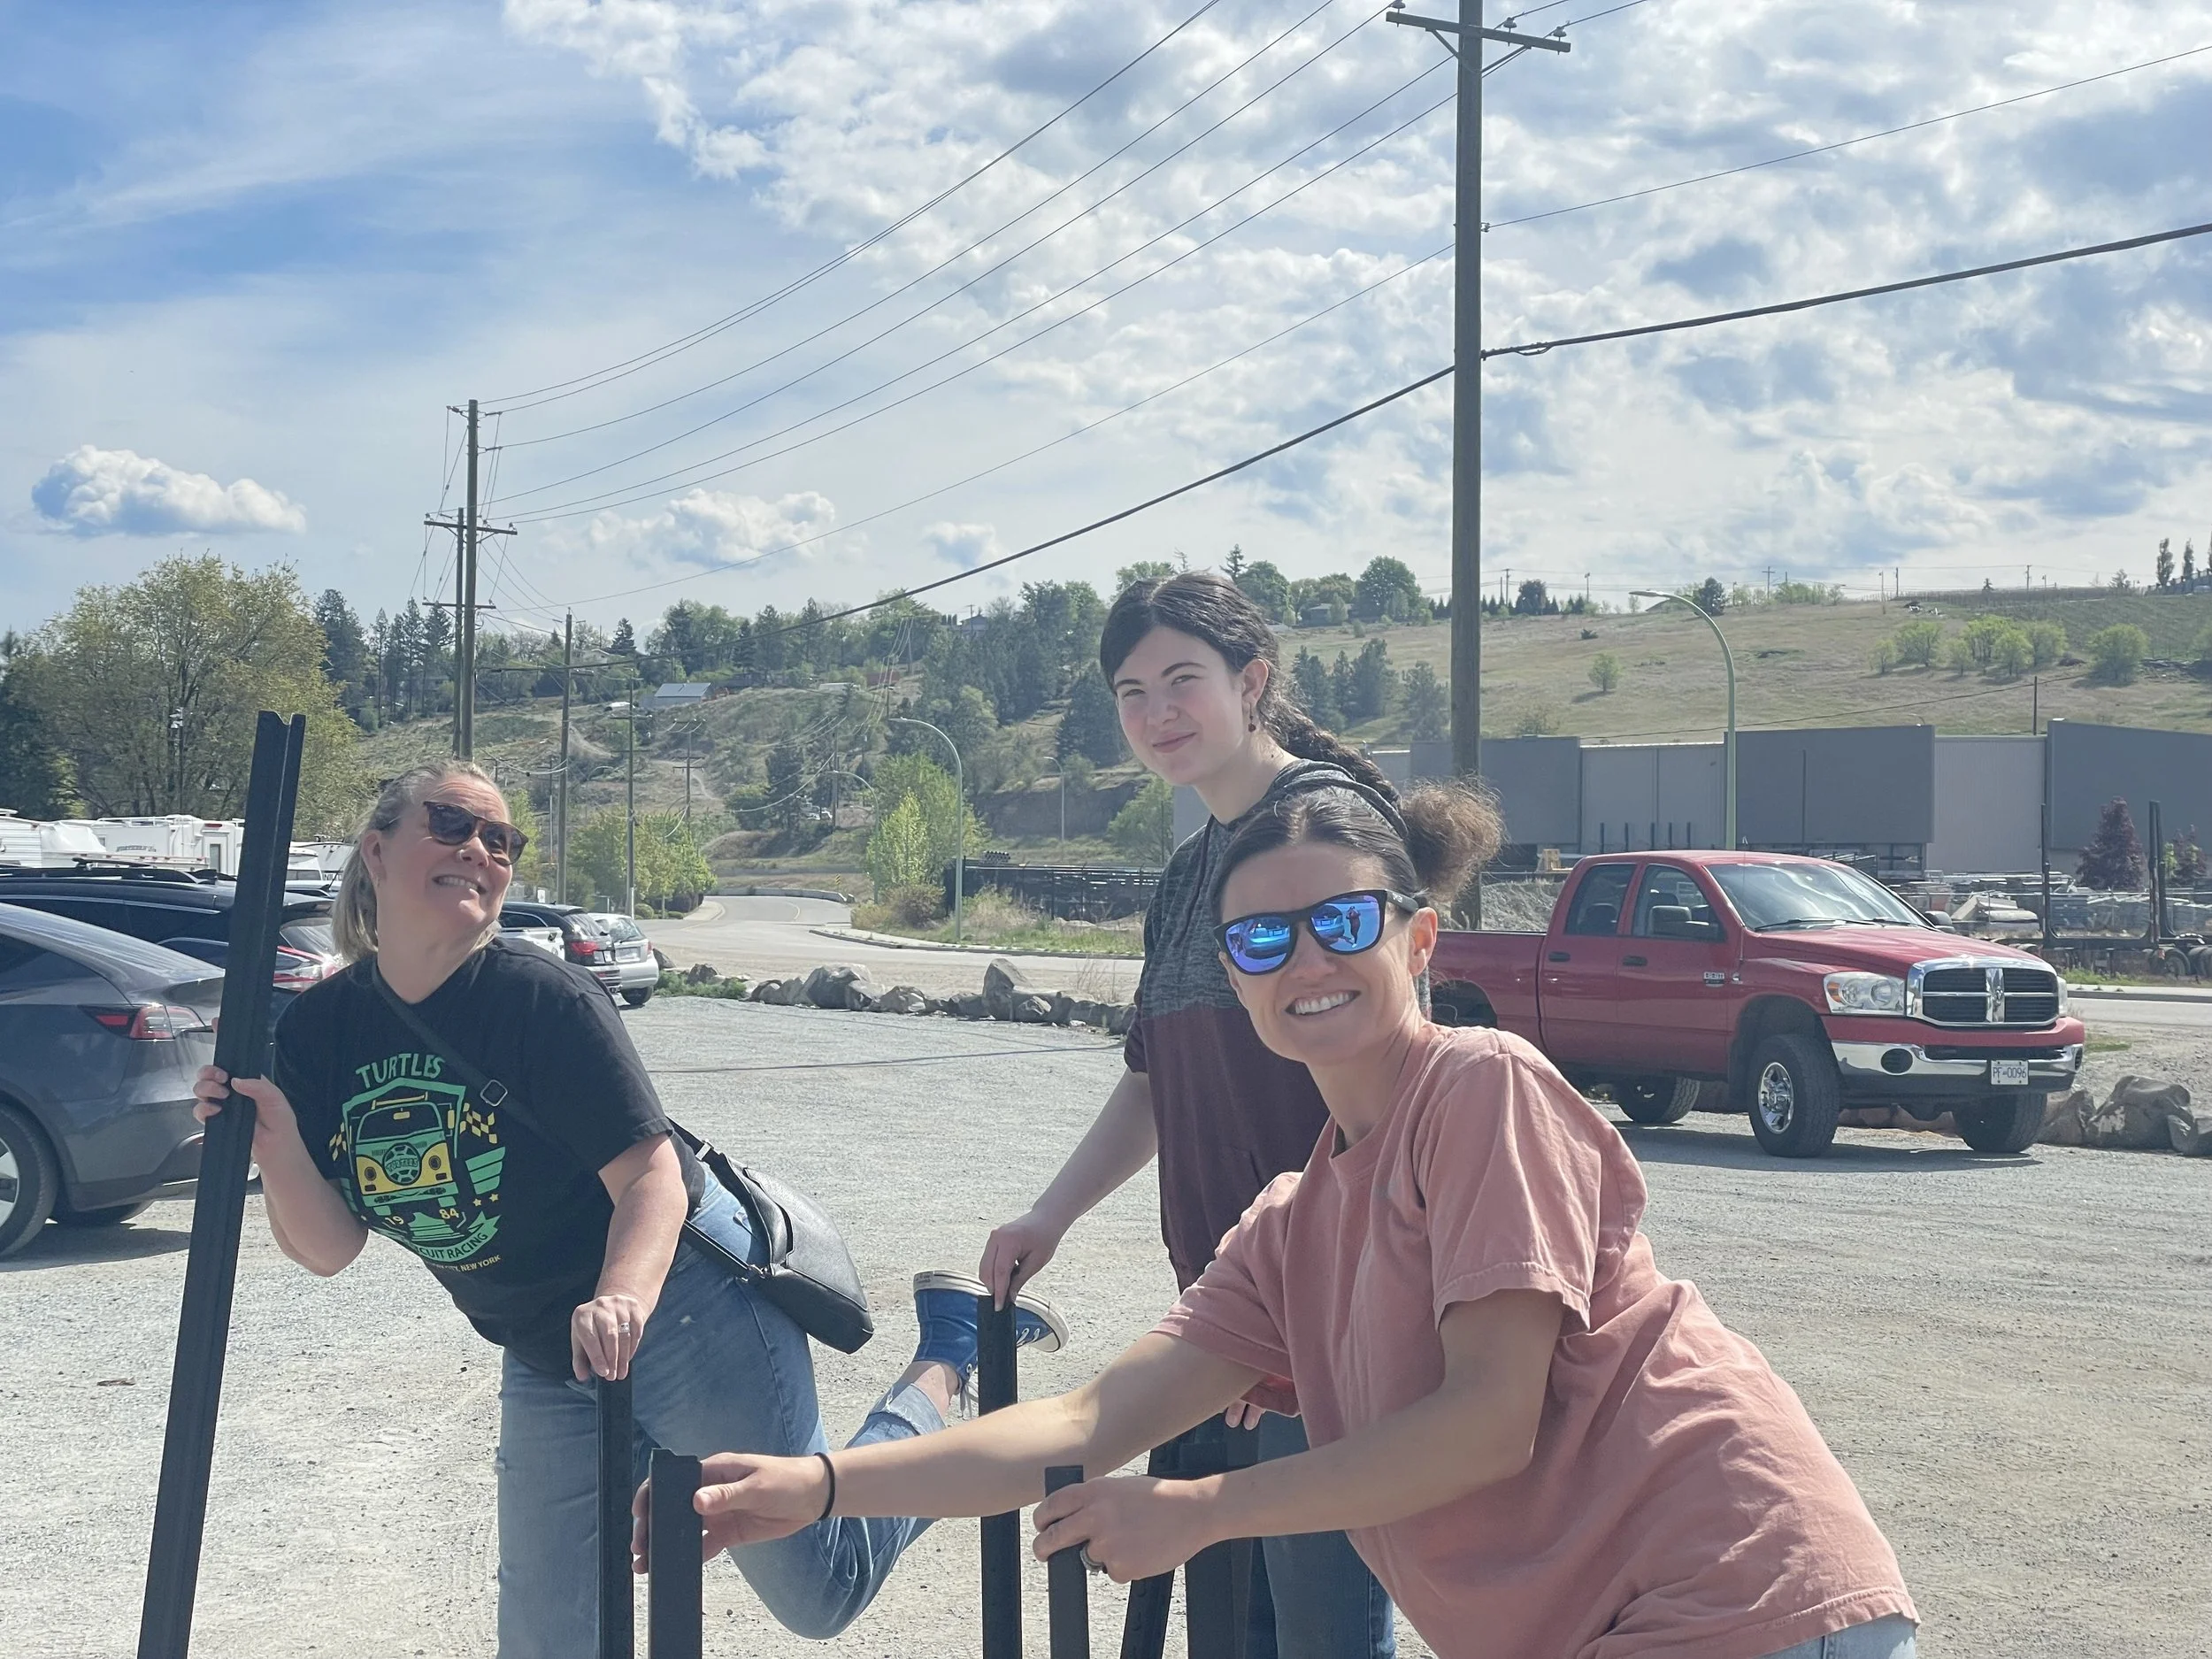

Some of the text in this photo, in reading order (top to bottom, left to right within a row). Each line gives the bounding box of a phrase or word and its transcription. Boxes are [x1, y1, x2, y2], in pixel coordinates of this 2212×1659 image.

[356, 1053, 445, 1088] TURTLES
[447, 1232, 488, 1259] RACING
[460, 1263, 478, 1272] NEW
[478, 1255, 502, 1268] YORK
